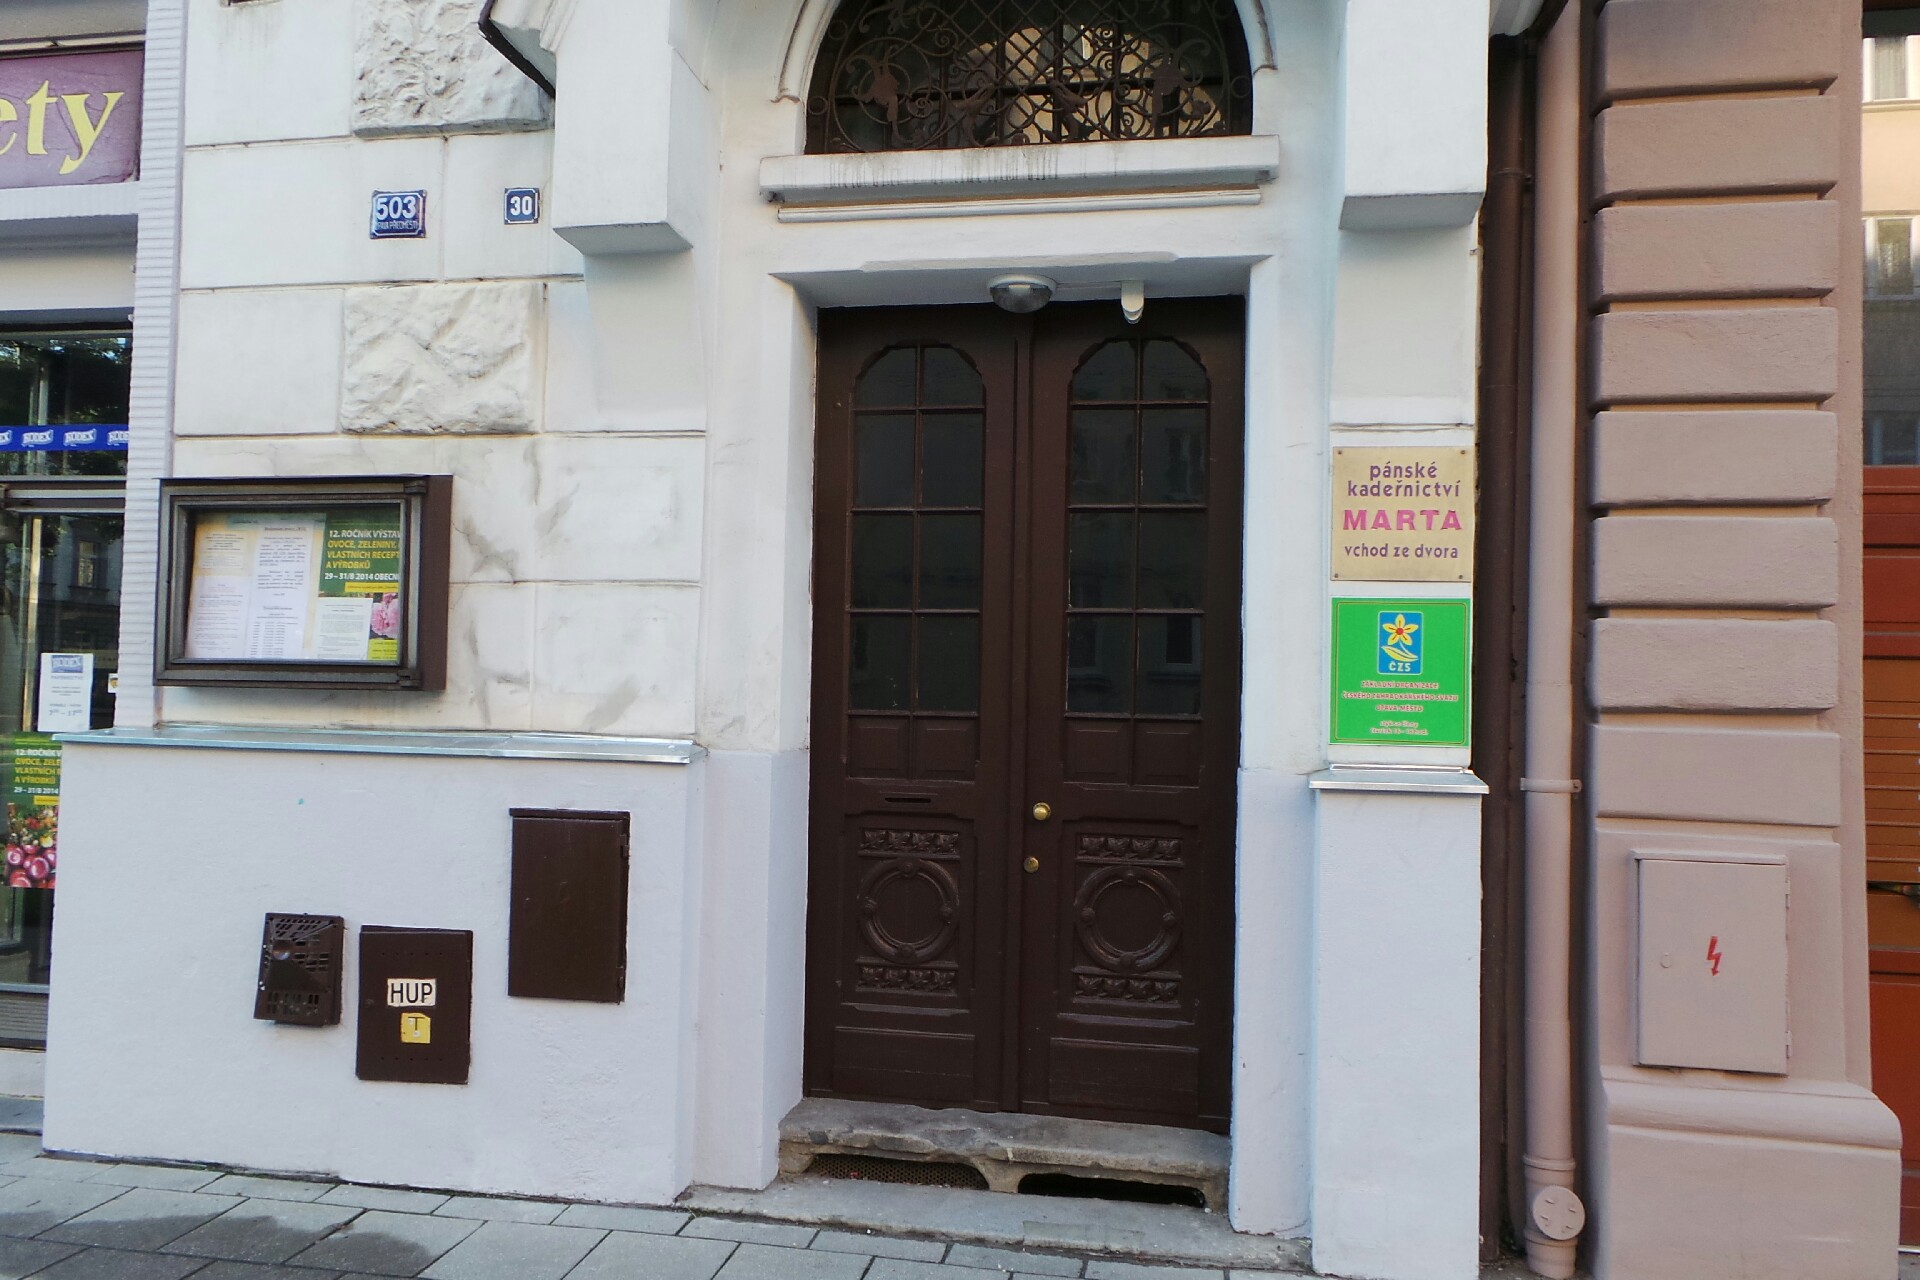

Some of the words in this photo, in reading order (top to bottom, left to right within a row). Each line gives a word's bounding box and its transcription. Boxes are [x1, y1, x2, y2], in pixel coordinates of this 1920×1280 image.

[376, 195, 416, 220] 503
[510, 195, 532, 216] 30
[1370, 461, 1437, 481] pánské
[1347, 479, 1461, 497] kadeřnictví
[1343, 509, 1462, 530] MARTA
[329, 530, 340, 538] 12.
[341, 528, 371, 538] ROČNÍK
[358, 540, 397, 549] ZELENINY,
[1344, 543, 1388, 557] vchod
[1393, 546, 1410, 557] ze
[1415, 544, 1458, 558] dvora
[327, 549, 370, 559] VLASTNÍCH
[325, 560, 332, 569] A
[332, 560, 371, 569] VÝROBKŮ
[324, 572, 333, 580] 29
[354, 573, 373, 581] 2014
[1388, 661, 1411, 672] ČZS
[391, 982, 433, 1004] HUP
[408, 1016, 425, 1031] T
